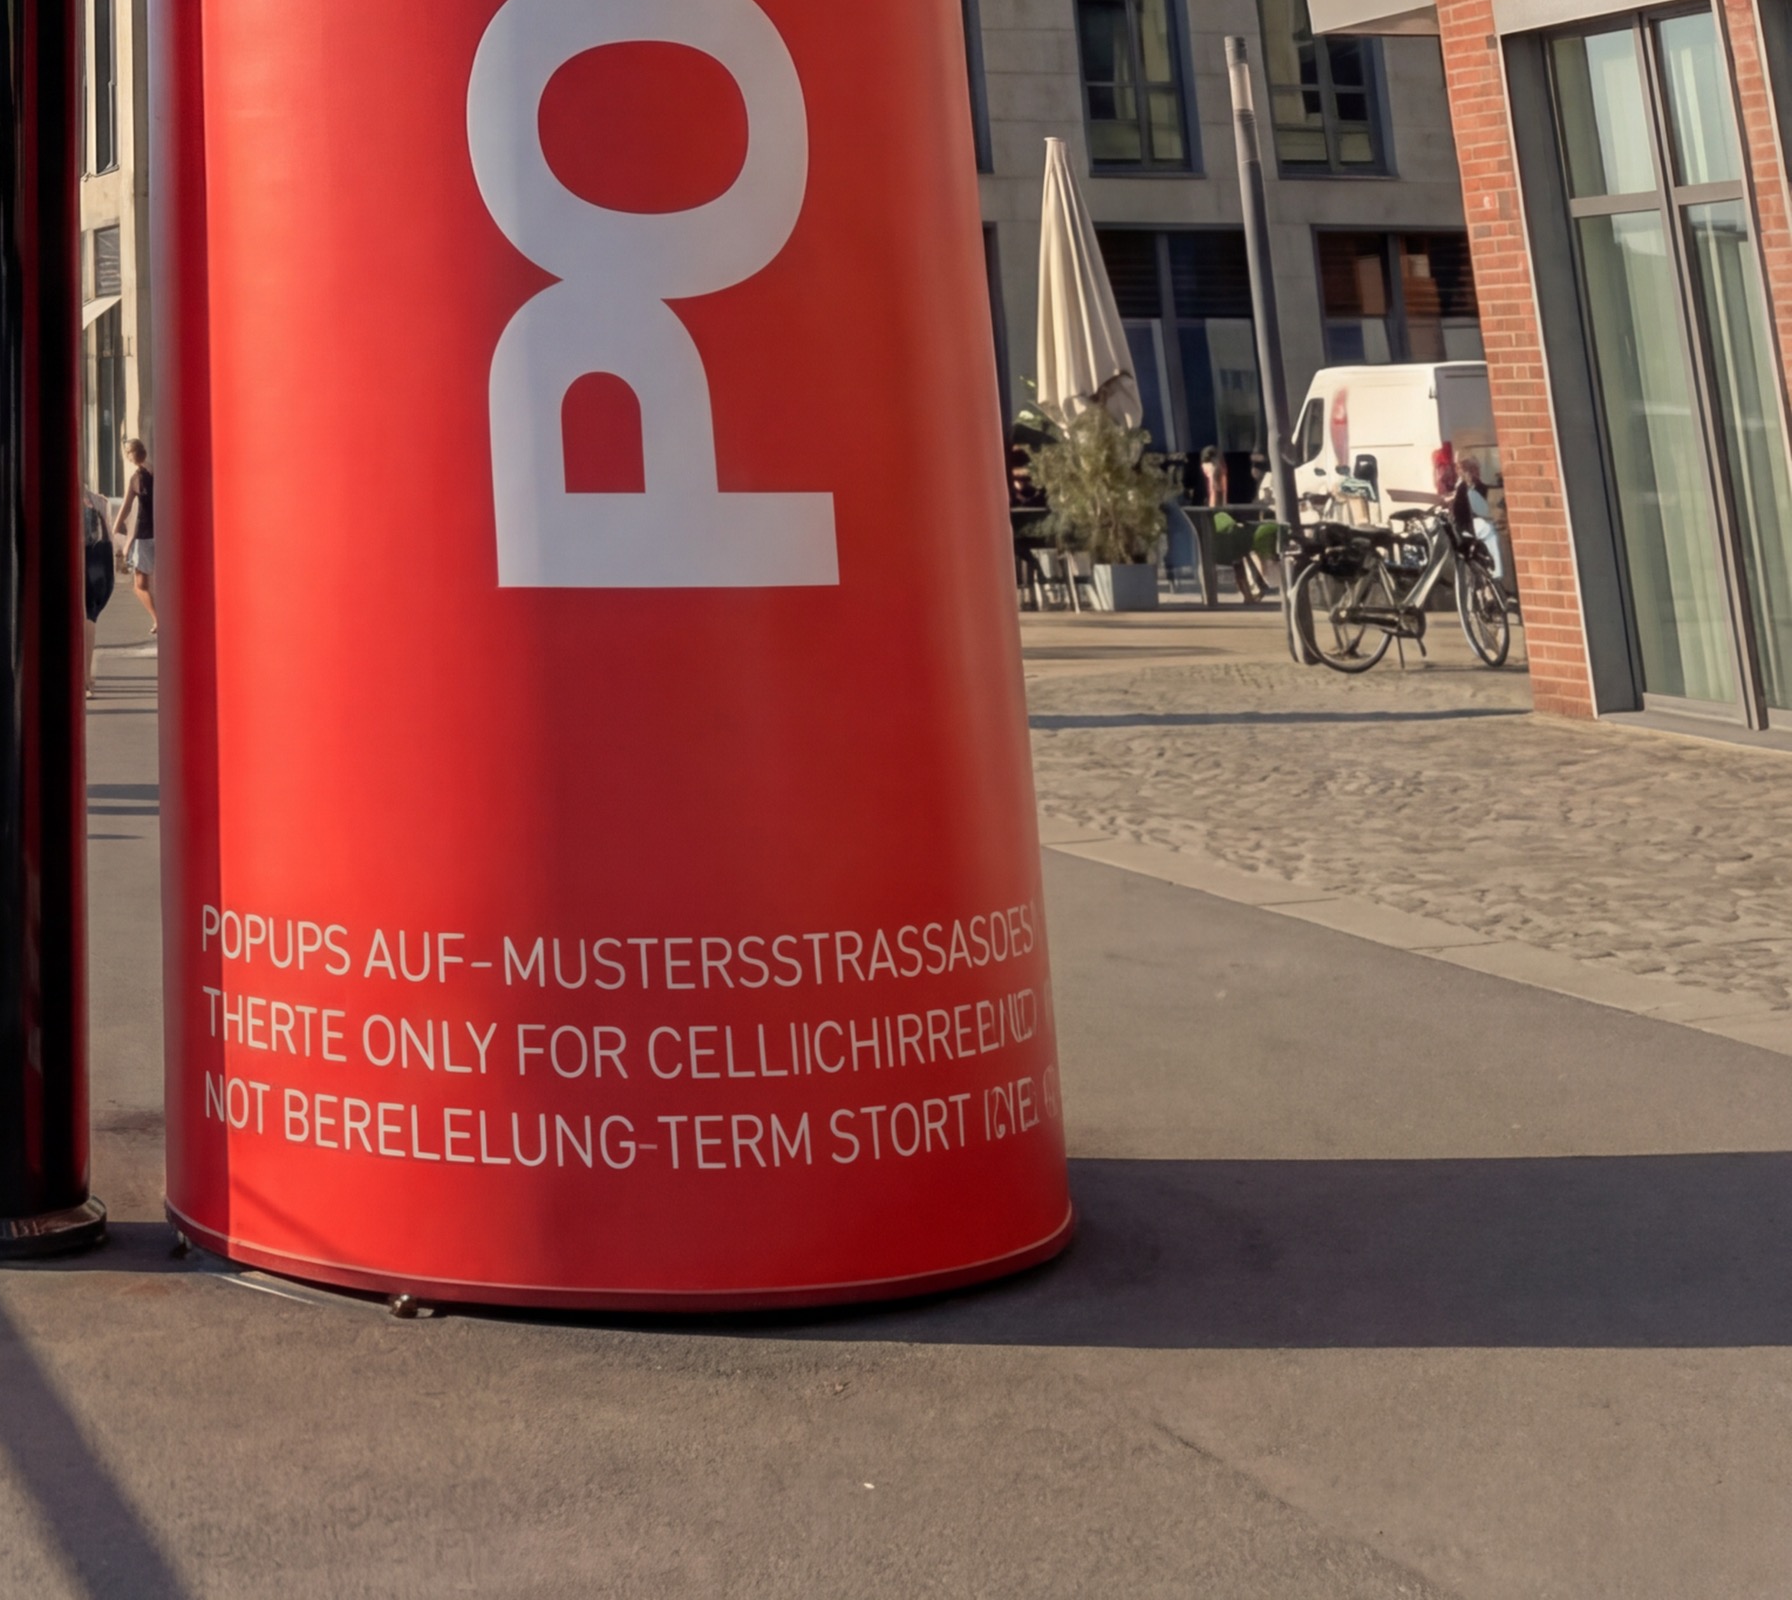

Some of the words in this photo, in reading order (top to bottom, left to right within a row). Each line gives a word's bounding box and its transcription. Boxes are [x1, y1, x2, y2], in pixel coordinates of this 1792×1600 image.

[202, 903, 352, 976] POPUPS
[202, 985, 348, 1063] THERTE
[361, 1013, 498, 1075] ONLY
[516, 1023, 629, 1080] FOR
[205, 1070, 271, 1135] NOT
[829, 1092, 972, 1165] STORT
